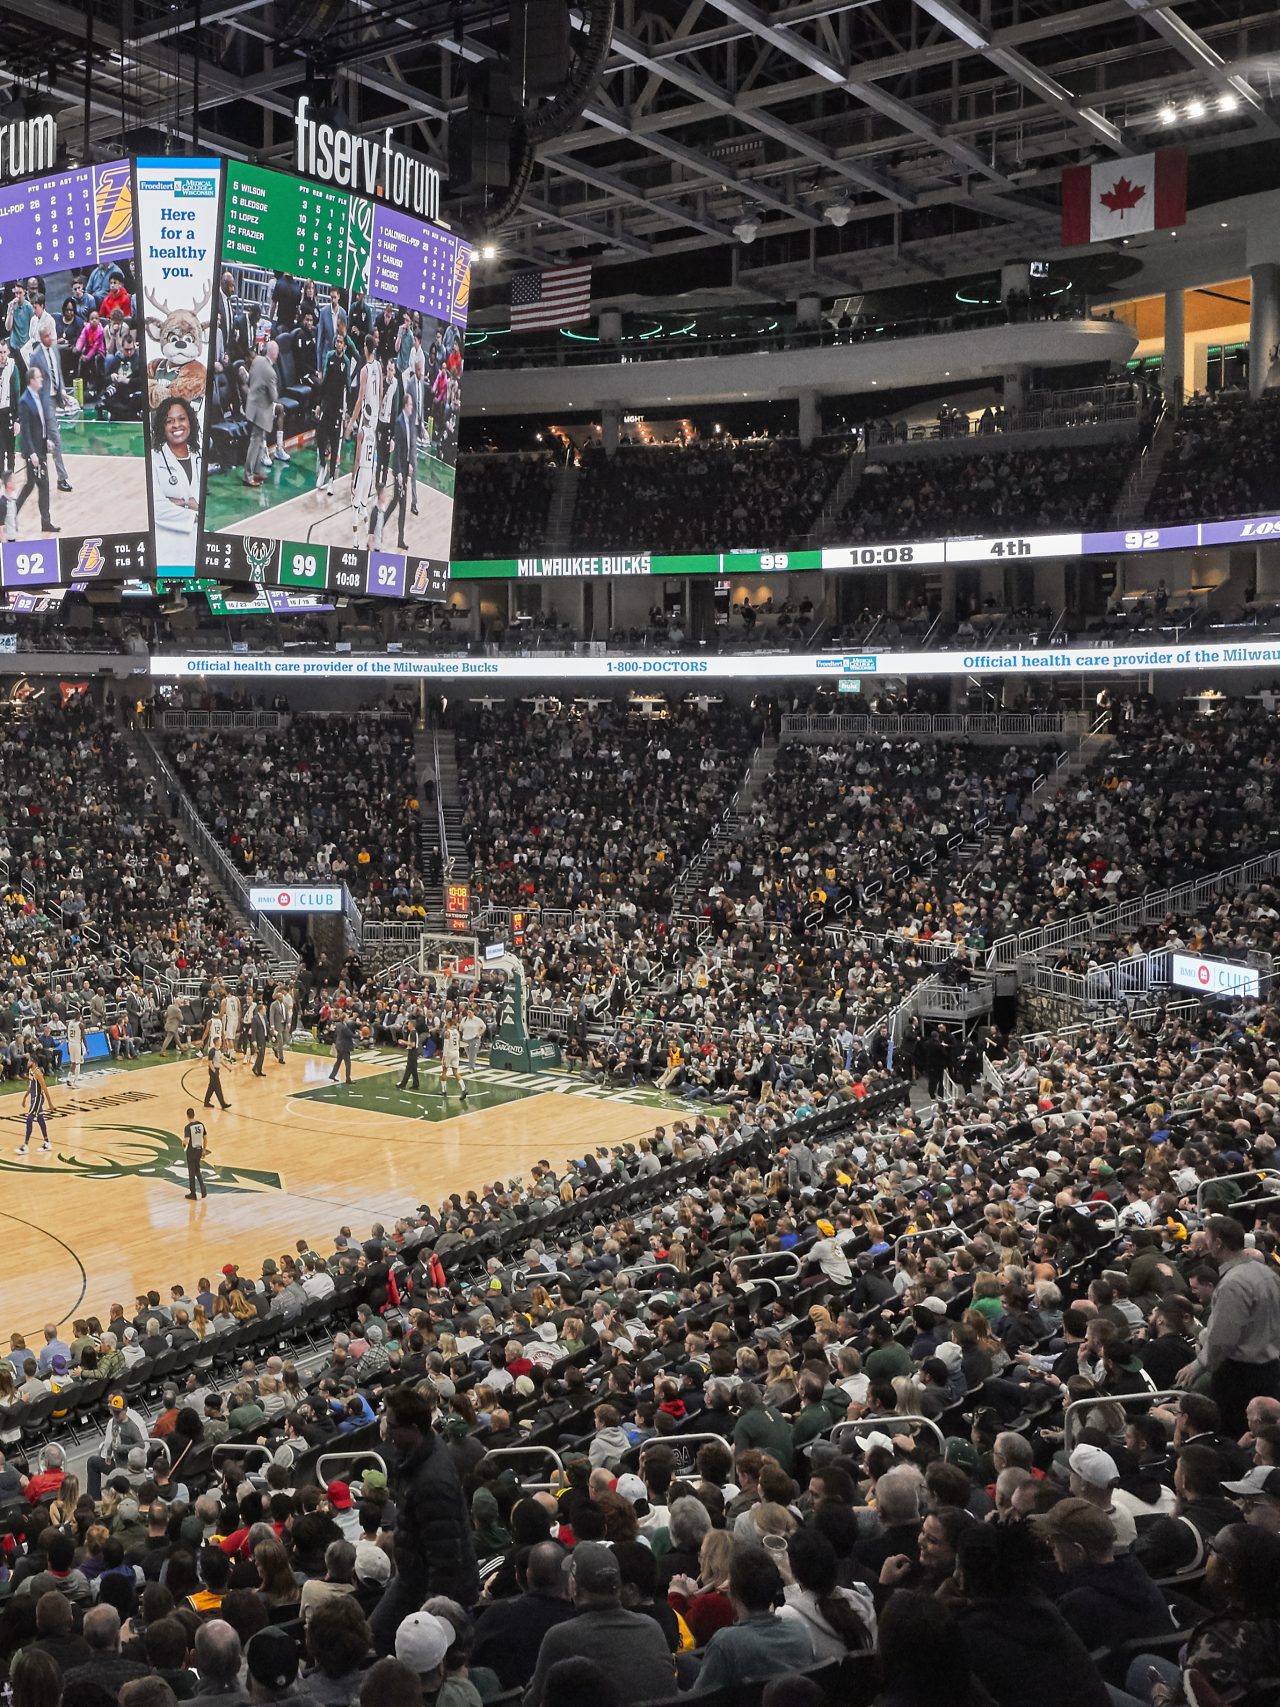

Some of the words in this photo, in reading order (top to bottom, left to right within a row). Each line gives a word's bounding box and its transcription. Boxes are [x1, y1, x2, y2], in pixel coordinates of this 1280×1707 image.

[241, 183, 266, 198] WILSON
[29, 199, 40, 210] 28
[240, 198, 268, 212] BLEDSOE
[299, 214, 307, 223] 10
[160, 208, 196, 221] Here
[230, 209, 237, 219] 11
[238, 212, 259, 225] LOPEZ
[296, 227, 306, 237] 24
[160, 226, 182, 240] for
[227, 224, 236, 234] 12
[238, 227, 265, 241] FRAZIER
[149, 245, 207, 261] healthy
[226, 240, 235, 250] 21
[236, 242, 257, 255] SNELL
[383, 240, 398, 252] HART
[34, 256, 43, 266] 13
[162, 267, 193, 280] you.
[365, 445, 373, 462] 12
[114, 544, 131, 553] TOL
[137, 541, 146, 553] 4
[1124, 531, 1159, 550] 92
[206, 543, 220, 553] TOL
[224, 543, 232, 555] 3
[990, 540, 1032, 558] 4th
[205, 557, 219, 566] FLS
[223, 557, 231, 569] 2
[341, 553, 358, 566] 4th
[760, 553, 788, 570] 99
[849, 547, 914, 566] 10:08
[16, 553, 45, 575] 92
[292, 554, 317, 577] 99
[517, 557, 599, 577] MILWAUKEE
[601, 556, 651, 575] BUCKS
[335, 572, 360, 587] 10:08
[378, 565, 397, 586] 92
[17, 600, 32, 609] 92
[187, 660, 230, 671] Official
[233, 660, 270, 671] health
[275, 663, 300, 672] care
[303, 661, 353, 673] provider
[356, 661, 369, 672] of
[371, 662, 391, 672] the
[393, 662, 459, 673] Milwaukee
[461, 662, 499, 673] Bucks
[963, 654, 1018, 669] Official
[1021, 653, 1071, 668] health
[1075, 655, 1110, 666] care
[1113, 651, 1173, 668] provider
[1176, 650, 1192, 663] of
[1194, 650, 1220, 663] the
[606, 661, 708, 673] 1-800-DOCTORS
[300, 893, 334, 905] CLUB
[448, 887, 467, 897] 10:08
[448, 896, 465, 911] 24
[1180, 966, 1196, 977] BMO
[1218, 971, 1251, 993] CLUB
[69, 1029, 76, 1038] 21
[214, 1027, 221, 1035] 12
[493, 1041, 524, 1053] SARGENTO
[194, 1126, 202, 1135] 35
